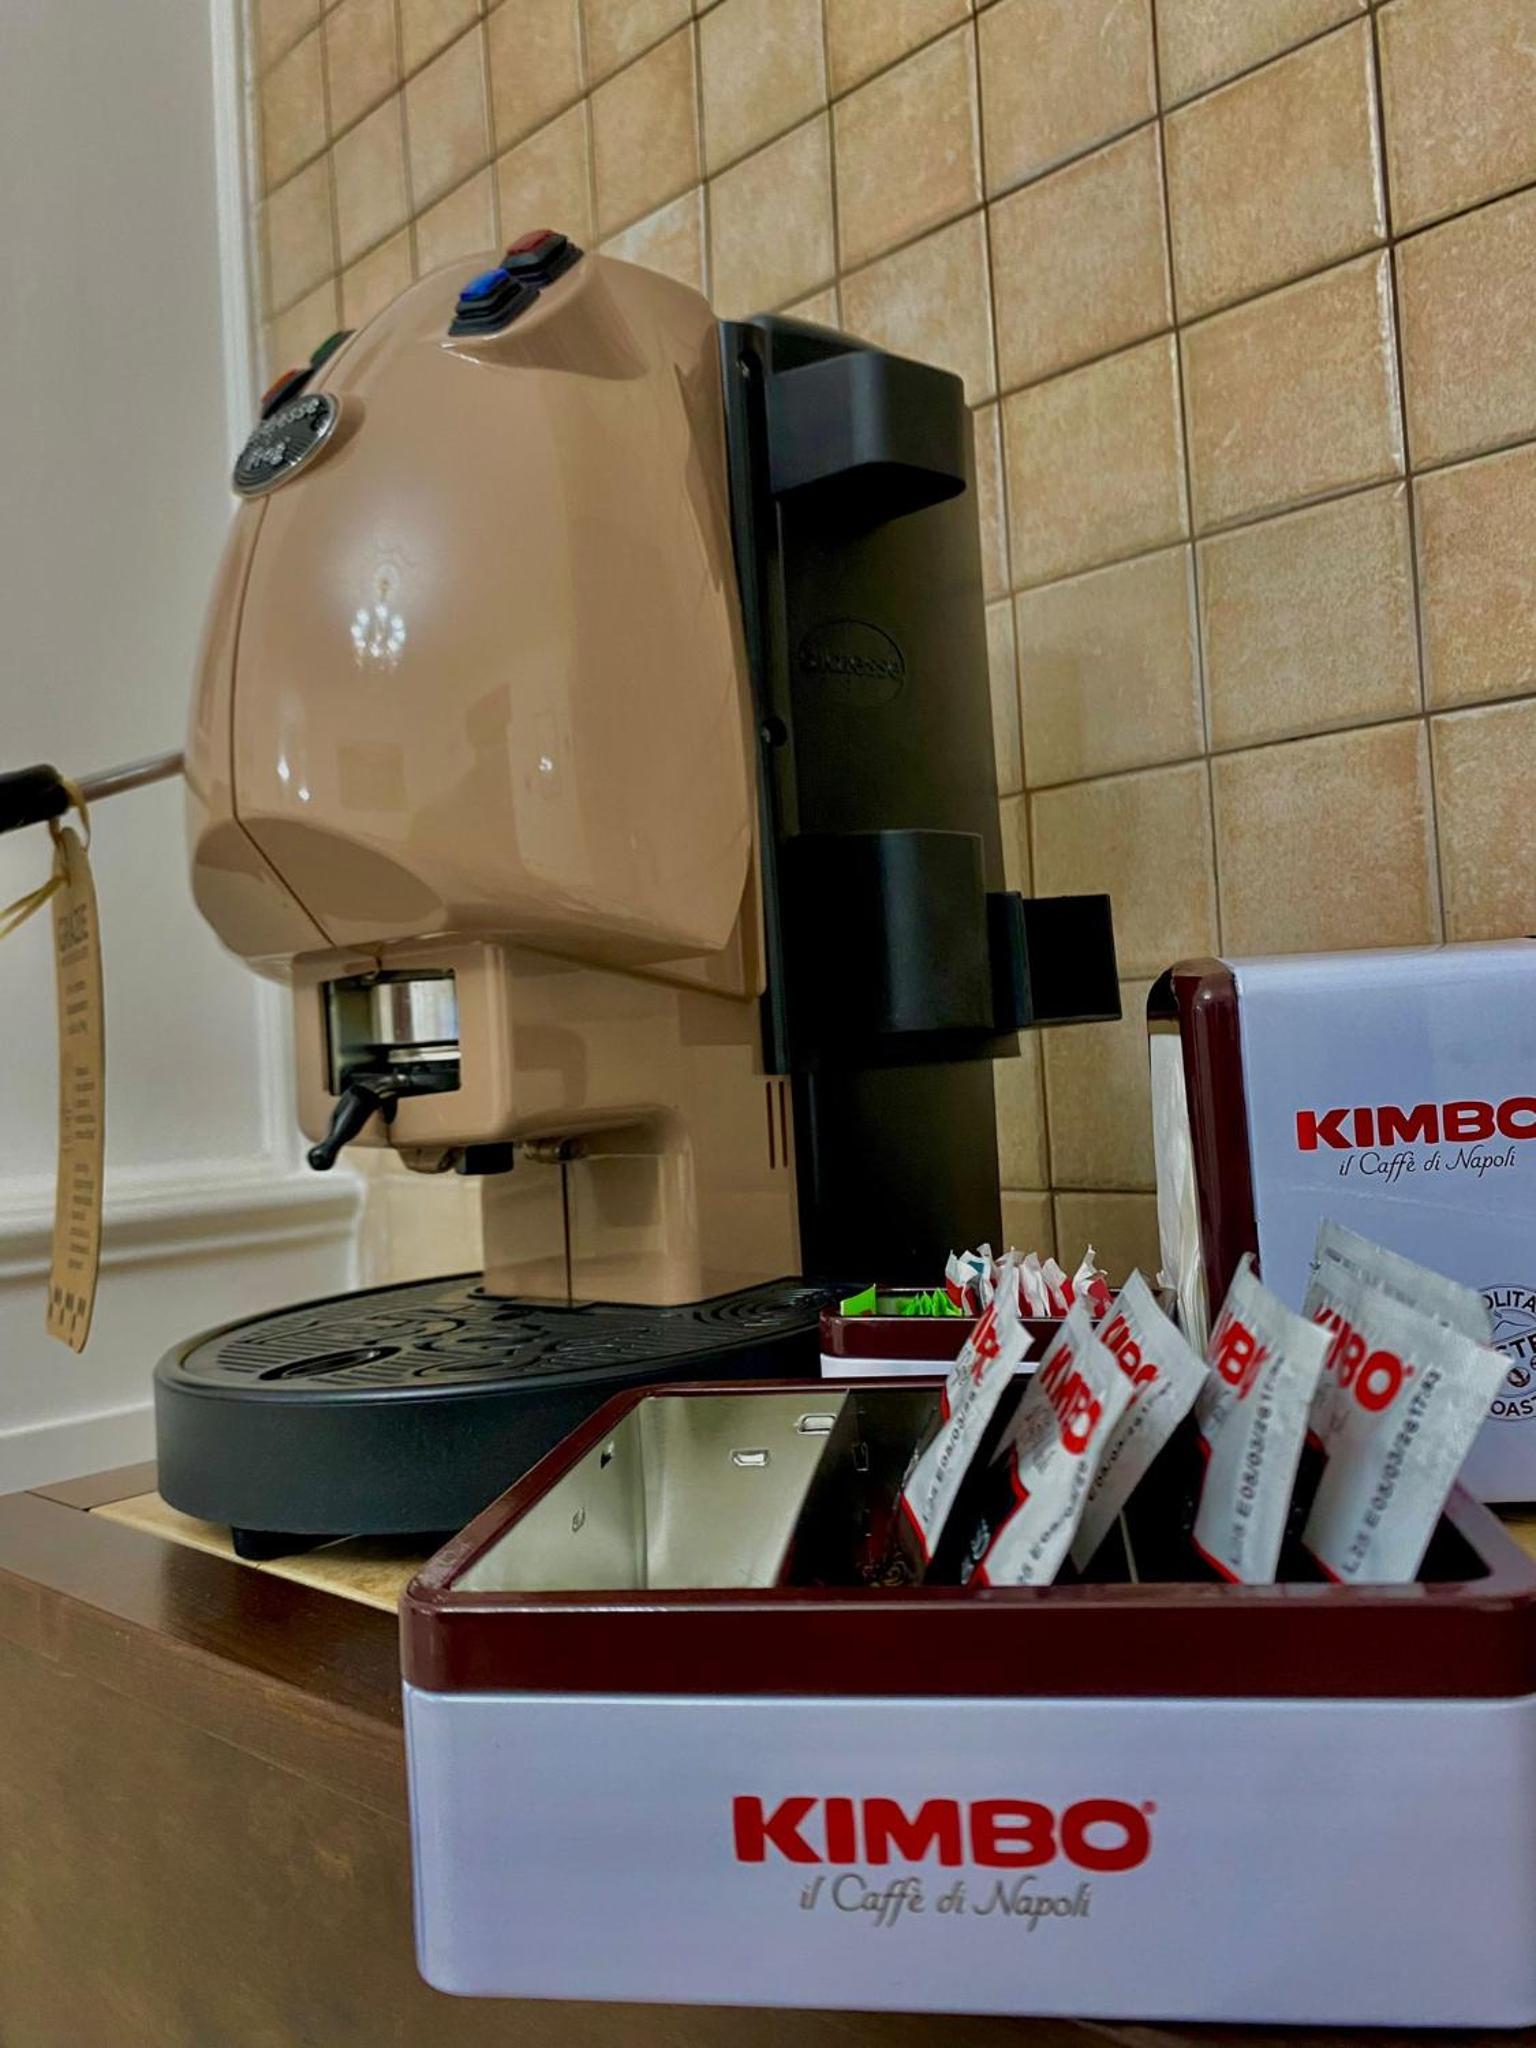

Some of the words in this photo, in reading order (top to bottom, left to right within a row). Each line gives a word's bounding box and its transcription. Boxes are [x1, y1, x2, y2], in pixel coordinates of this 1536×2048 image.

[1296, 1097, 1536, 1150] KIMBO
[1339, 1155, 1354, 1176] il
[1360, 1152, 1416, 1183] Caffè
[1424, 1151, 1441, 1172] di
[1446, 1145, 1515, 1178] Napoli
[732, 1796, 1152, 1872] KIMBO
[800, 1876, 826, 1910] il
[832, 1873, 925, 1928] Caffè
[936, 1880, 967, 1914] di
[972, 1875, 1091, 1932] Napoli
